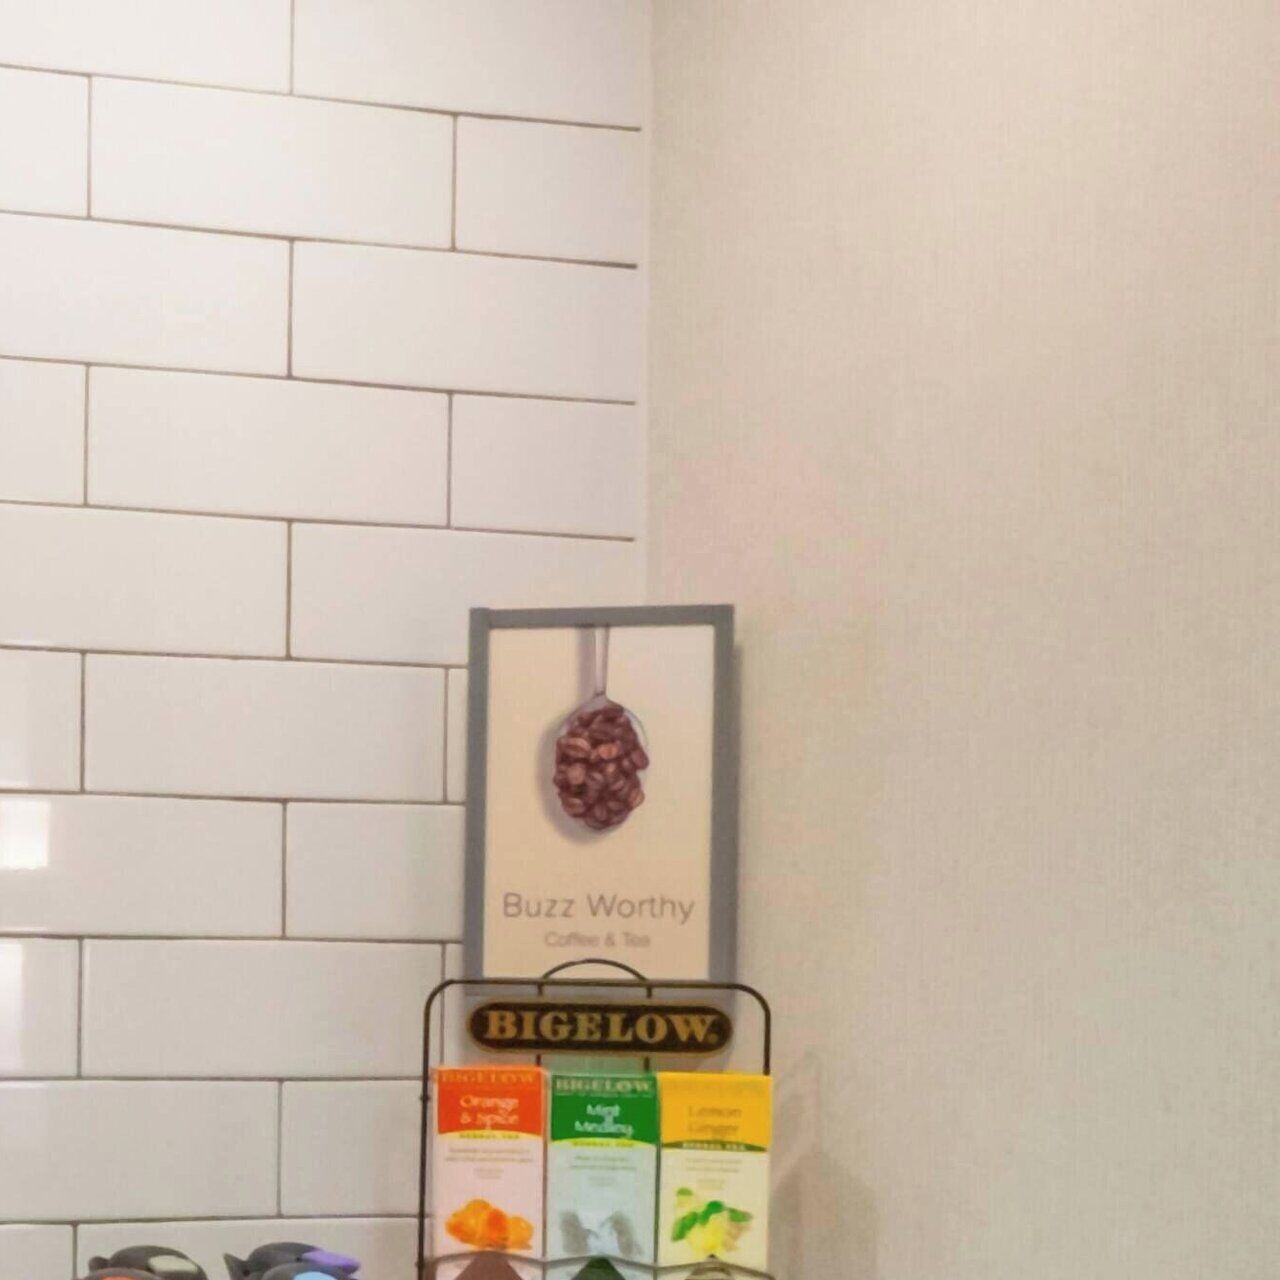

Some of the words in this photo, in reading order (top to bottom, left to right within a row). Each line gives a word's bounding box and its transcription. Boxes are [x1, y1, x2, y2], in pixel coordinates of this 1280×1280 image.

[502, 892, 576, 918] Buzz
[586, 893, 695, 925] Worthy
[544, 931, 600, 947] Coffee
[604, 932, 616, 947] &
[622, 932, 651, 947] Tea
[484, 1009, 719, 1044] BIGELOW
